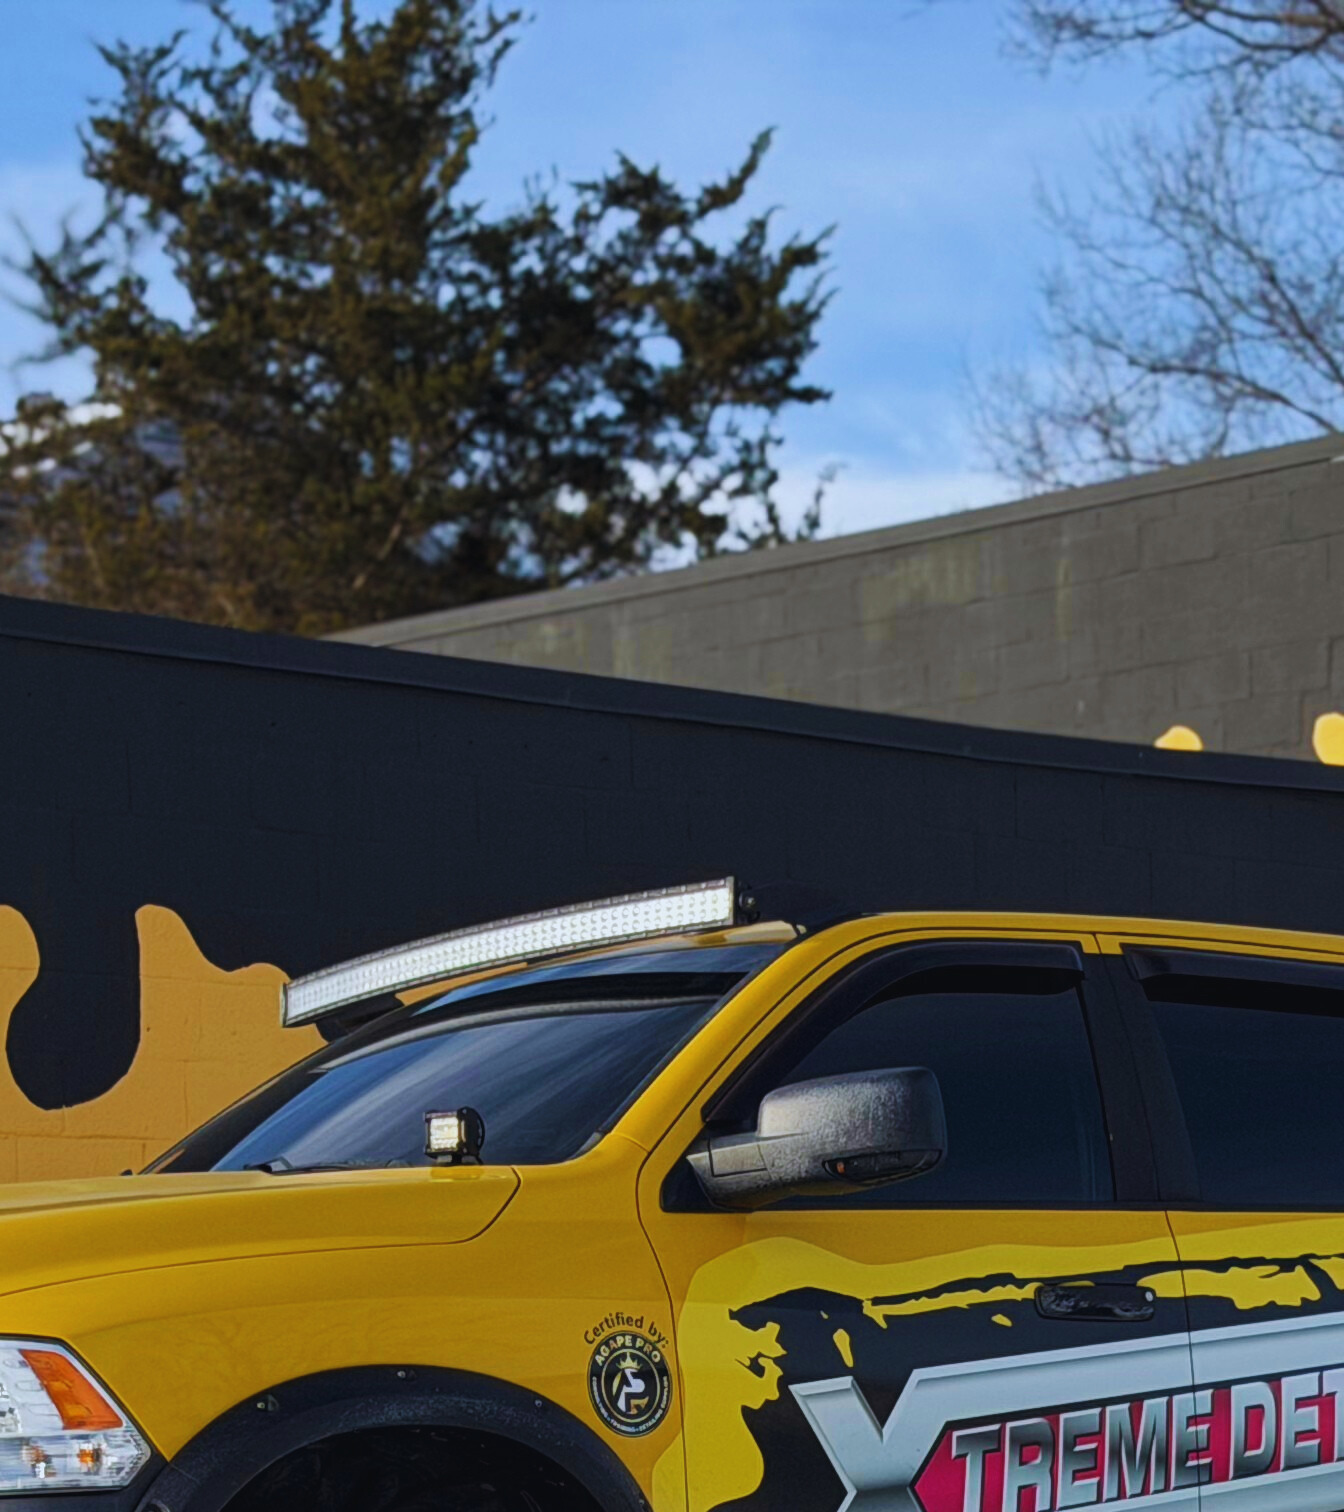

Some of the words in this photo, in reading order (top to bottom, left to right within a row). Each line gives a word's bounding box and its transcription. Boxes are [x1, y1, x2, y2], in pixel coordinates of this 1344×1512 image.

[584, 1312, 644, 1345] Certified
[648, 1321, 669, 1349] by:
[595, 1335, 633, 1366] AGAPE
[635, 1338, 661, 1363] PRO
